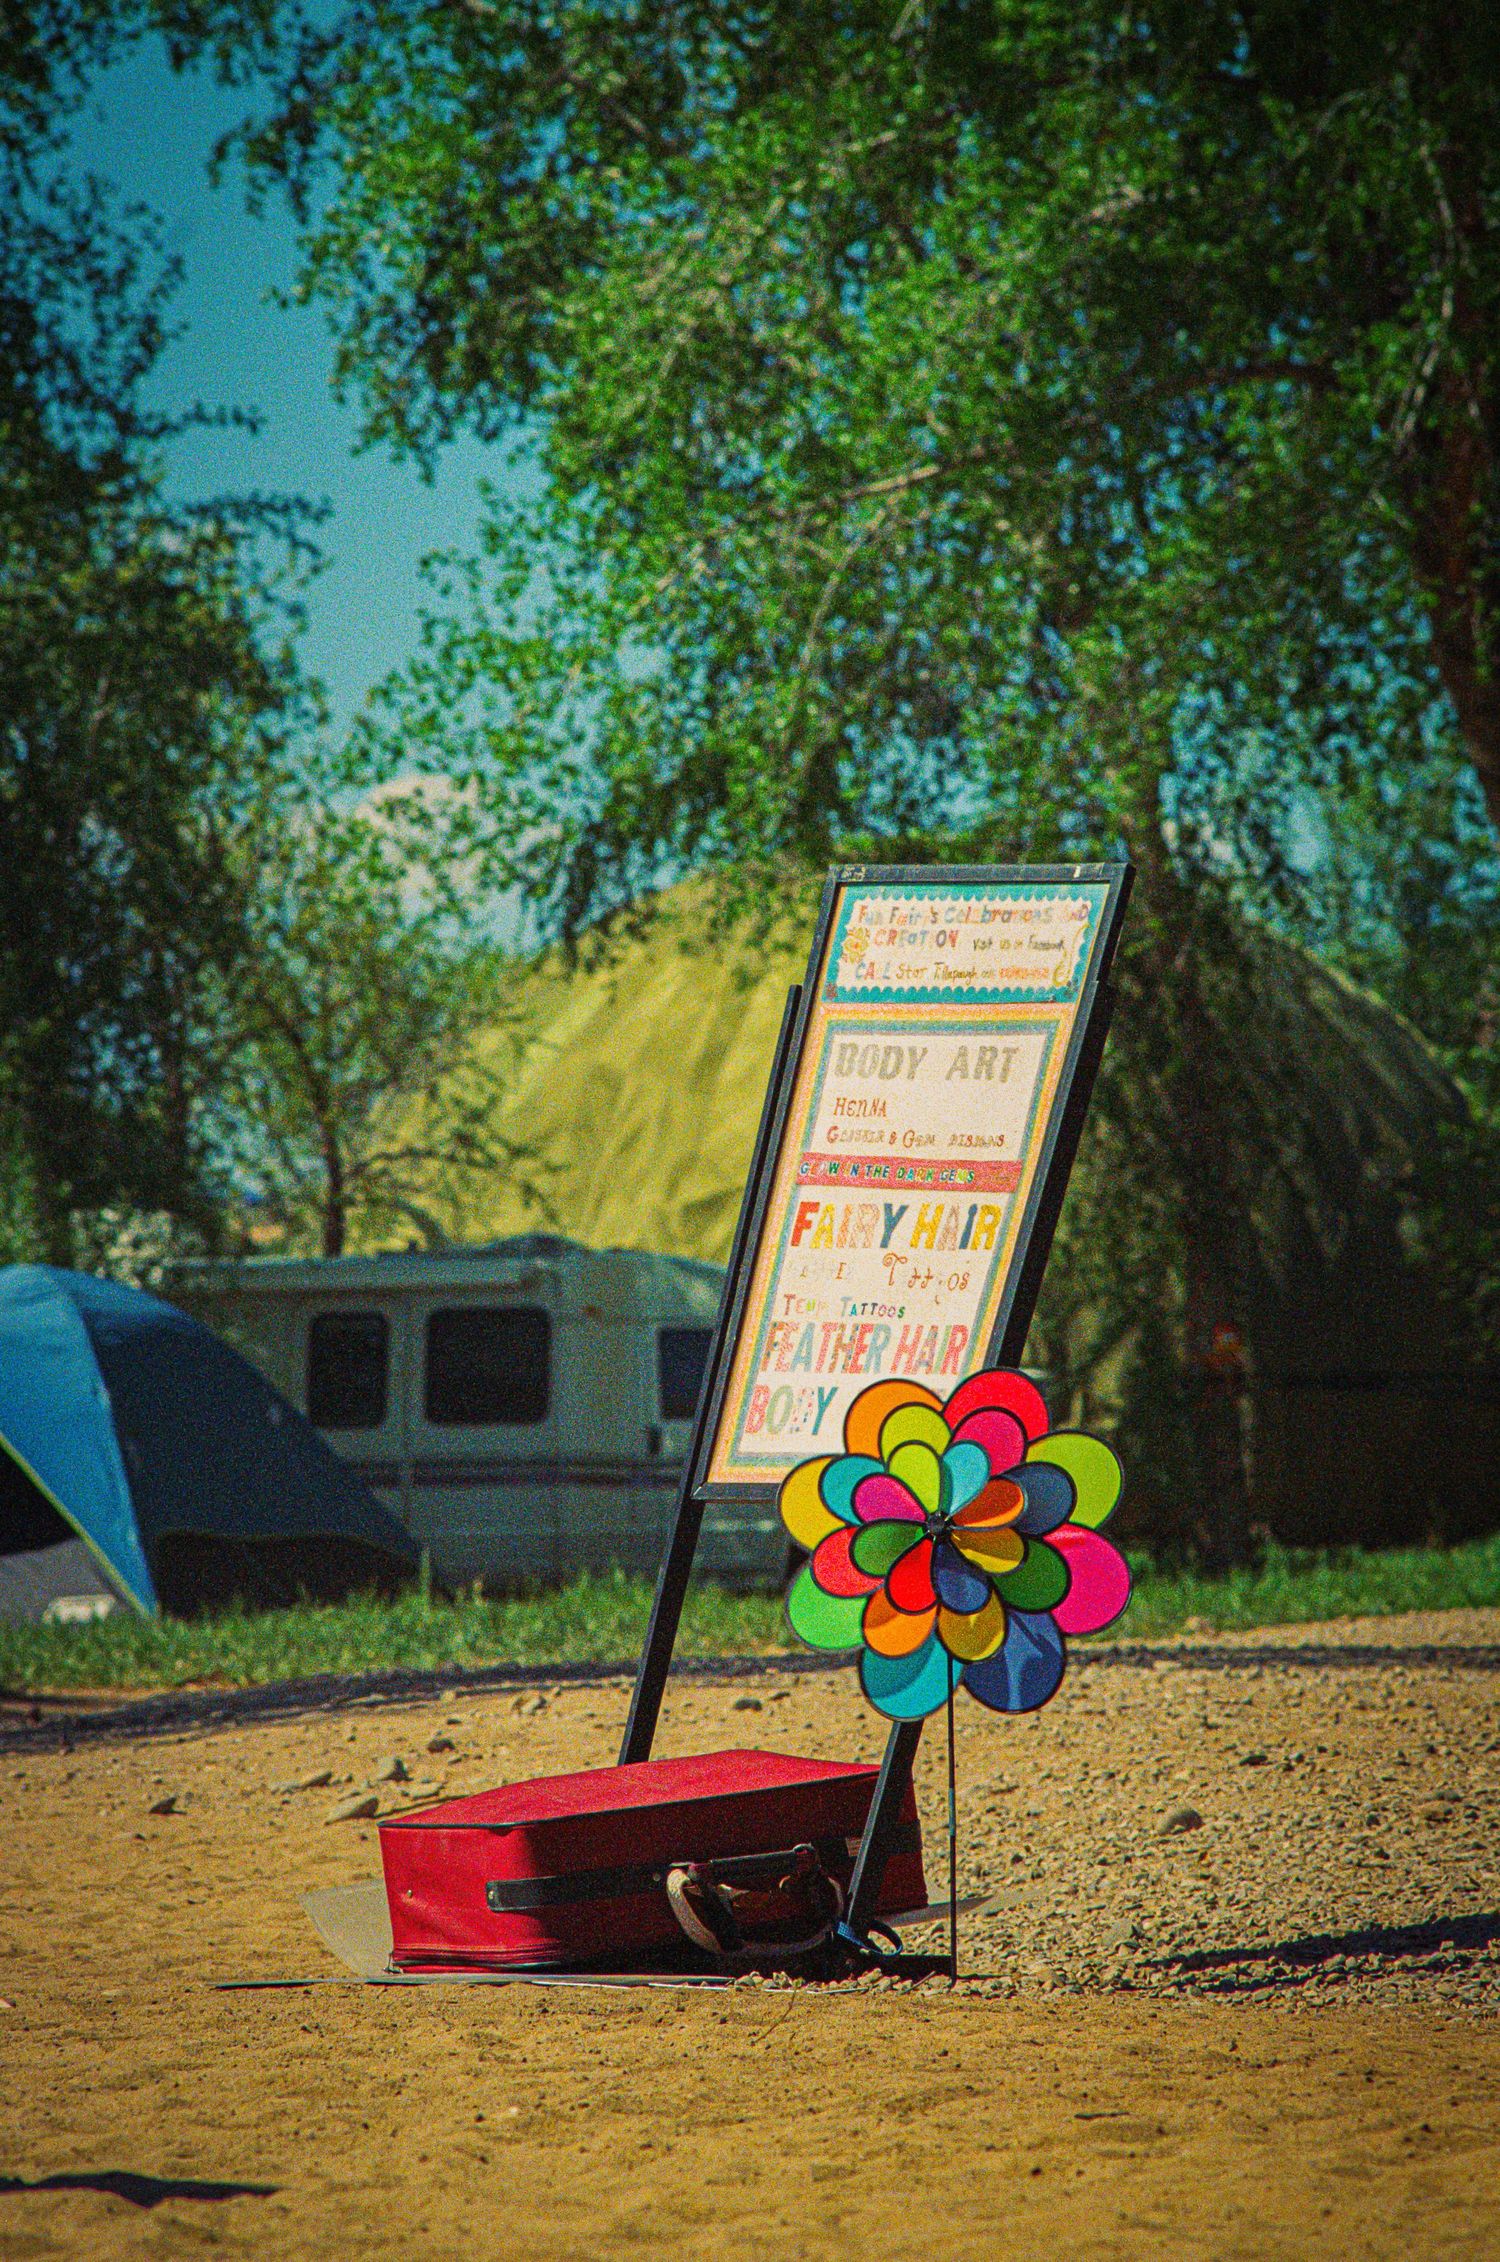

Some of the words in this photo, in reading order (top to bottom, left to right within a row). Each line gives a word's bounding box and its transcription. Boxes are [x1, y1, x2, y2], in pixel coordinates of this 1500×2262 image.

[855, 961, 890, 980] CAL
[834, 1042, 928, 1081] BODY
[946, 1045, 1019, 1083] ART
[864, 1163, 890, 1179] THE
[896, 1165, 934, 1182] DARK
[939, 1166, 976, 1183] GEMS
[790, 1200, 909, 1249] FAIRY
[909, 1202, 1006, 1251] HAIR
[760, 1321, 892, 1374] FEATHER
[890, 1324, 969, 1375] HAIR
[745, 1384, 838, 1436] BODY
